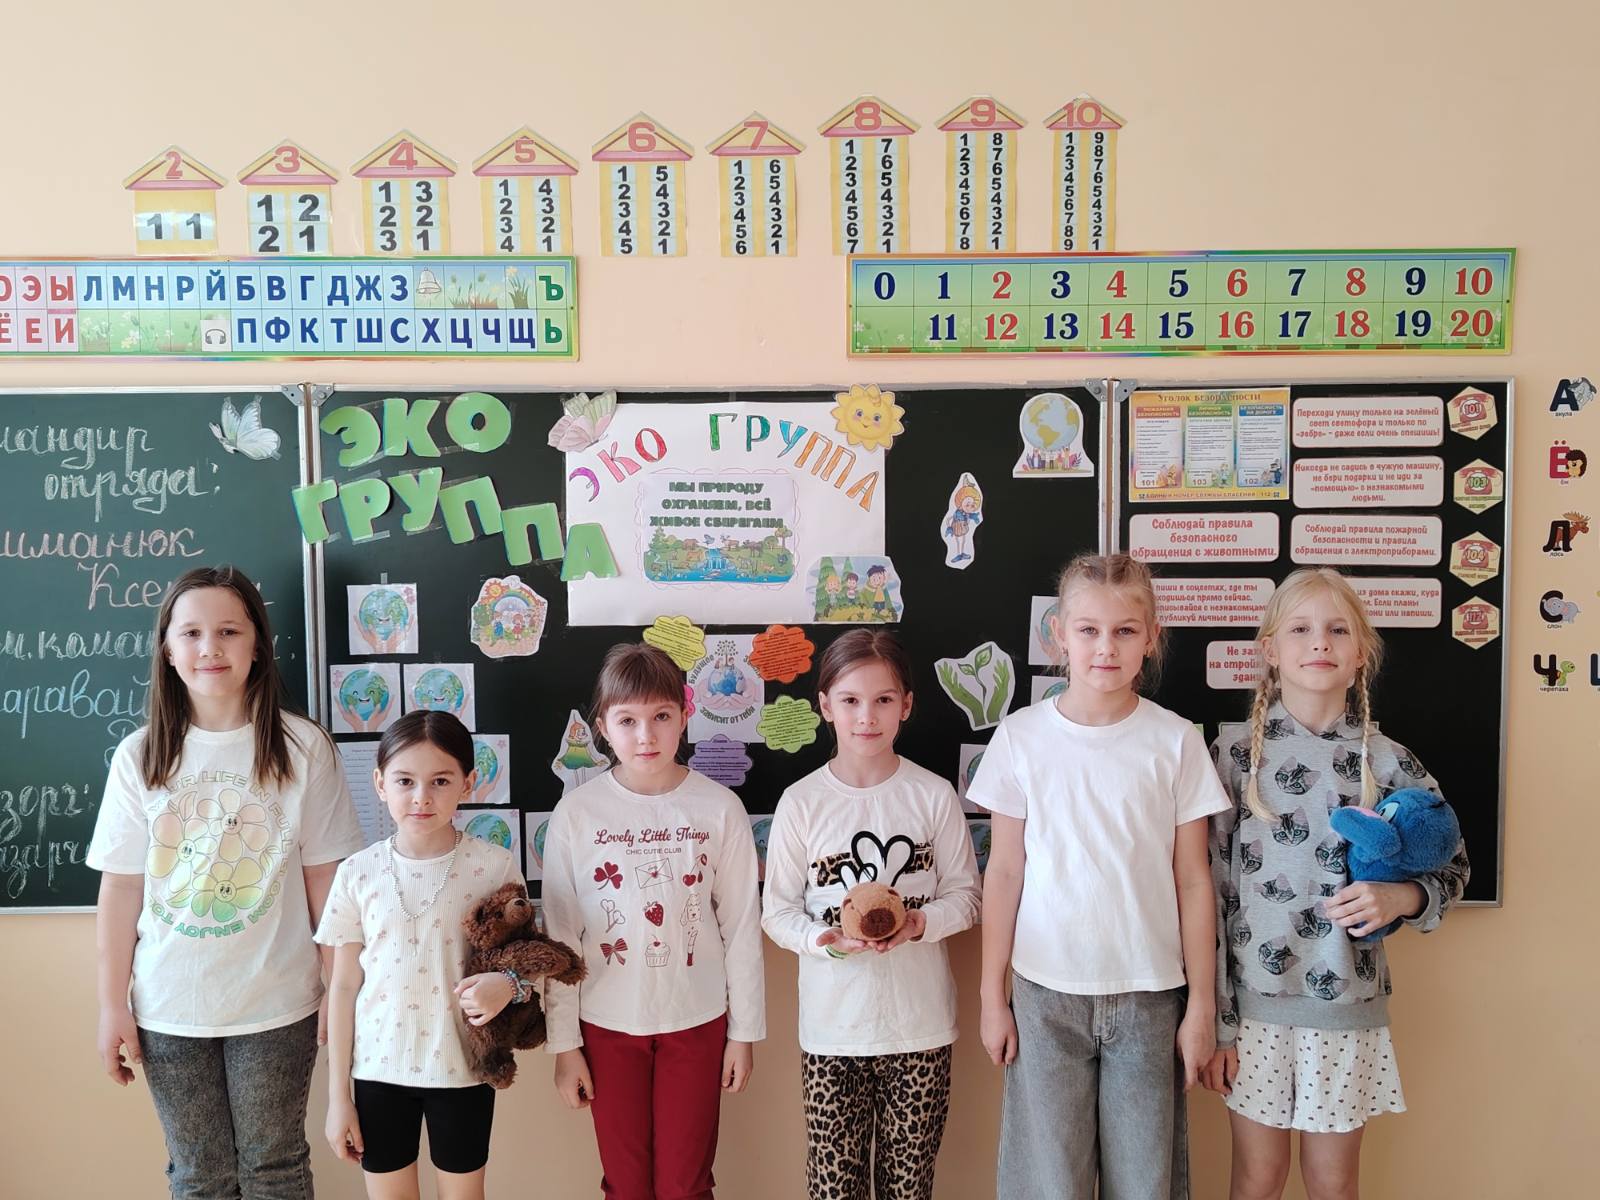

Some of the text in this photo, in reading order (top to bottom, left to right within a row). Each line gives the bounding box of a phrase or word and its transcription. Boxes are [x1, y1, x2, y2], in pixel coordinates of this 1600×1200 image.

[854, 102, 882, 130] 8
[970, 99, 996, 127] 9
[1062, 102, 1102, 127] 10
[627, 121, 656, 152] 6
[743, 121, 768, 150] 7
[274, 145, 301, 173] 3
[389, 142, 417, 170] 4
[515, 140, 536, 163] 5
[165, 151, 183, 178] 2
[22, 275, 41, 301] Э
[51, 275, 74, 301] Ы
[83, 276, 101, 302] Л
[113, 275, 135, 301] М
[145, 275, 164, 301] Н
[177, 275, 194, 301] Р
[206, 269, 225, 301] Й
[236, 275, 255, 301] Б
[267, 275, 286, 301] В
[300, 275, 314, 301] Г
[327, 275, 349, 306] Д
[356, 275, 381, 301] Ж
[391, 275, 408, 301] З
[539, 275, 564, 301] Ъ
[874, 267, 1493, 300] 0 1 2 3 4 5 6 7 8 9 10
[1549, 379, 1579, 411] А
[1297, 409, 1334, 418] Переходи
[1336, 410, 1360, 418] улицу
[1331, 419, 1377, 428] светофора
[319, 391, 512, 467] ЭКО
[1334, 430, 1354, 438] даже
[569, 413, 880, 512] ЭКО ГРУППА
[1295, 464, 1328, 473] Никогда
[1341, 464, 1368, 473] садись
[1376, 464, 1404, 472] чужую
[1549, 440, 1570, 478] Ё
[669, 482, 764, 494] МЫ ПРИРОДУ
[1324, 474, 1342, 483] бери
[1344, 474, 1377, 483] подарки
[1397, 473, 1411, 481] иди
[1366, 484, 1425, 492] незнакомыми
[291, 466, 619, 582] ГРУППА
[649, 516, 700, 528] ЖИВОЕ
[1152, 518, 1253, 530] Соблюдай правила
[1305, 524, 1428, 535] Соблюдай правила пожарной
[1170, 532, 1238, 543] безопасного
[1312, 535, 1373, 544] безопасности
[1382, 538, 1417, 546] правила
[1543, 520, 1572, 552] Л
[1131, 547, 1277, 559] обращения с животными.
[1295, 546, 1343, 555] обращения
[1539, 590, 1564, 623] С
[1227, 646, 1239, 656] Не
[1209, 661, 1221, 669] на
[1533, 654, 1557, 687] Ч
[202, 771, 248, 787] LIFE
[594, 826, 710, 847] Lovely Little Things
[174, 920, 246, 939] ENJOY
